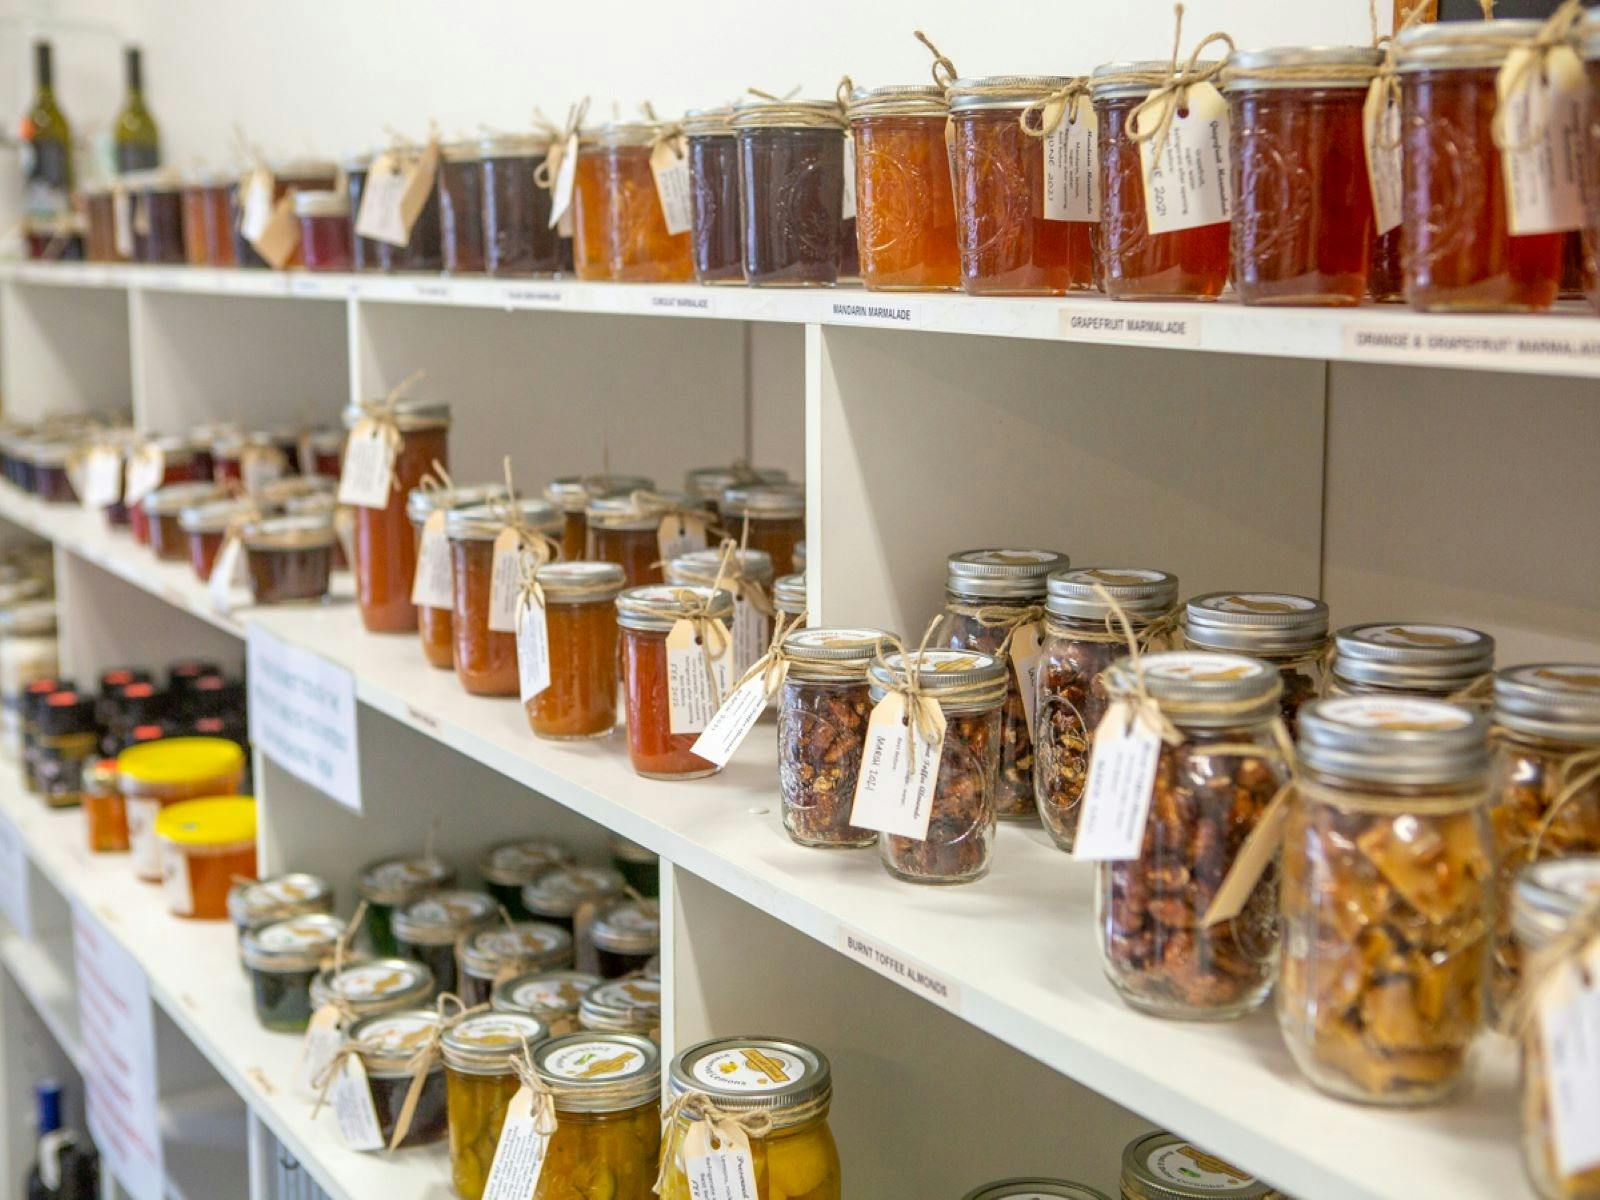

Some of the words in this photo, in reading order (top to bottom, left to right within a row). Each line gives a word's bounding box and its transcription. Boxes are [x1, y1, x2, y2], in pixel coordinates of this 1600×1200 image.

[832, 304, 866, 316] MANDARIN
[868, 306, 911, 320] MARMALADE
[1070, 315, 1125, 331] GRAPEFRUIT
[1126, 318, 1186, 335] MARMALADE
[871, 735, 886, 766] MARCH
[847, 936, 873, 959] BURNT
[875, 950, 905, 976] TOFFEE
